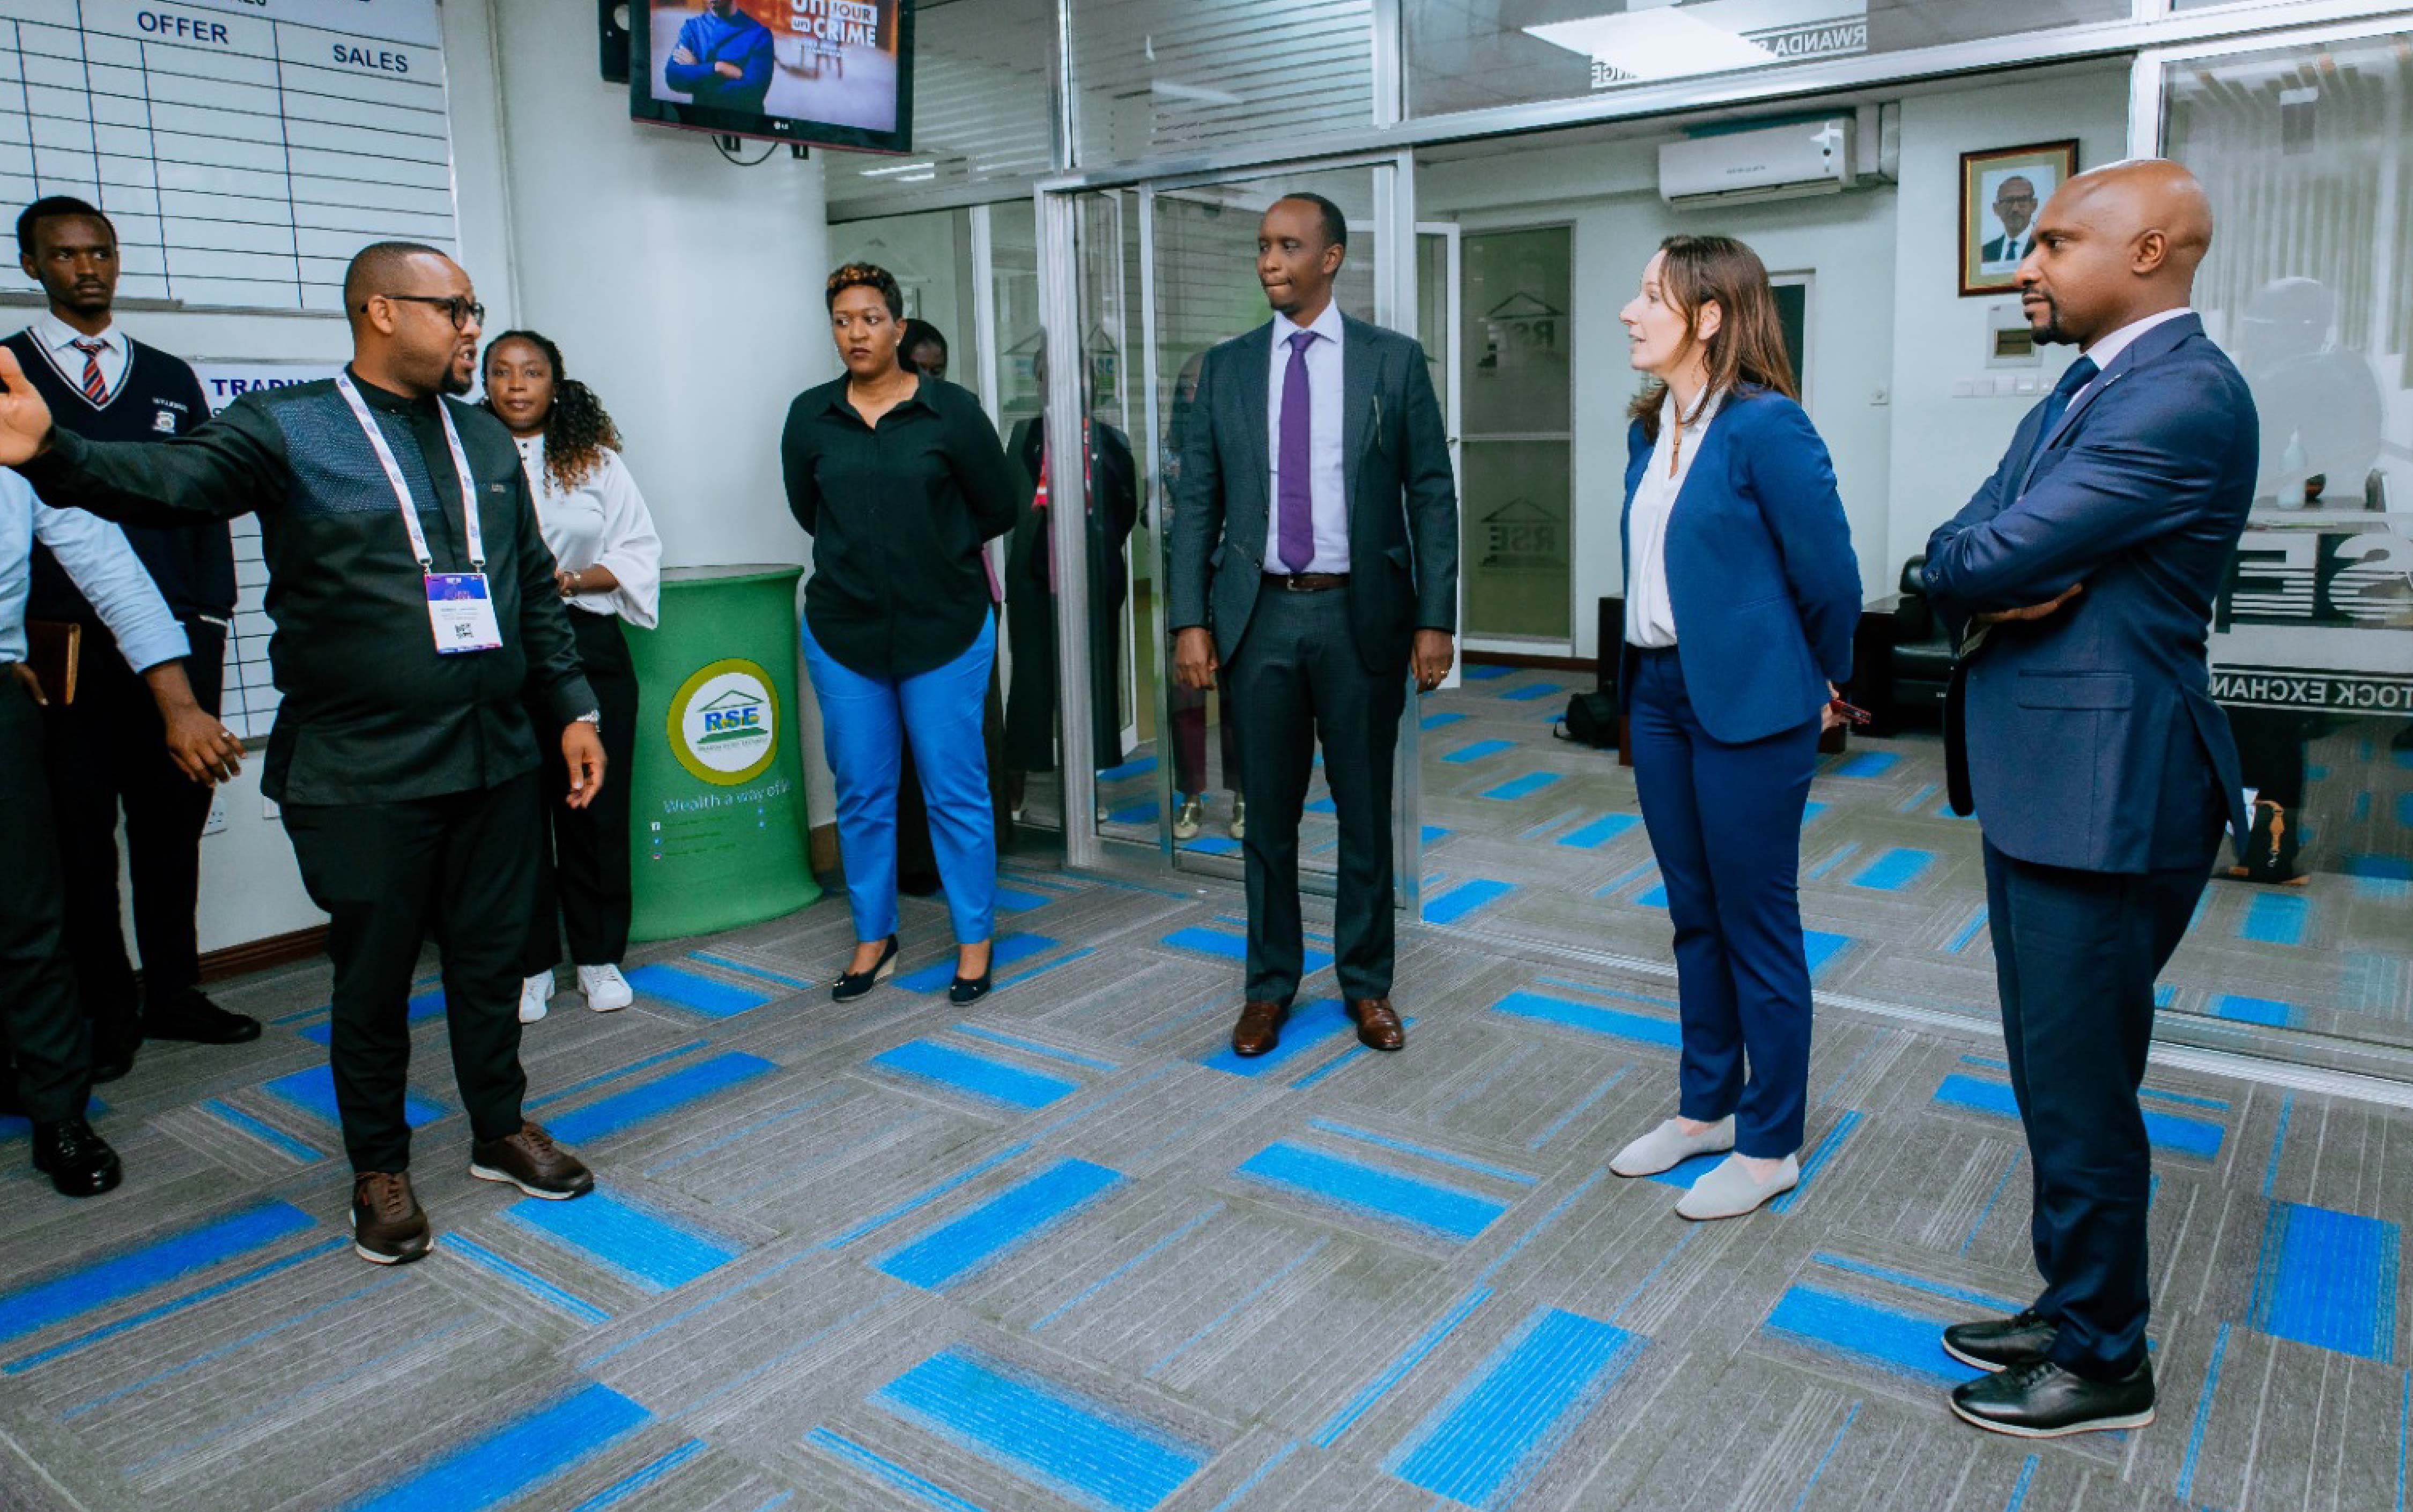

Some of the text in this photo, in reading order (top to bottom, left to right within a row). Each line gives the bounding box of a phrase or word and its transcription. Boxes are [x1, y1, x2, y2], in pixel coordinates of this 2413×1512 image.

[138, 11, 229, 44] OFFER
[813, 17, 876, 47] CRIME
[332, 44, 410, 73] SALES
[705, 706, 760, 732] RSE
[664, 794, 720, 813] Wealth
